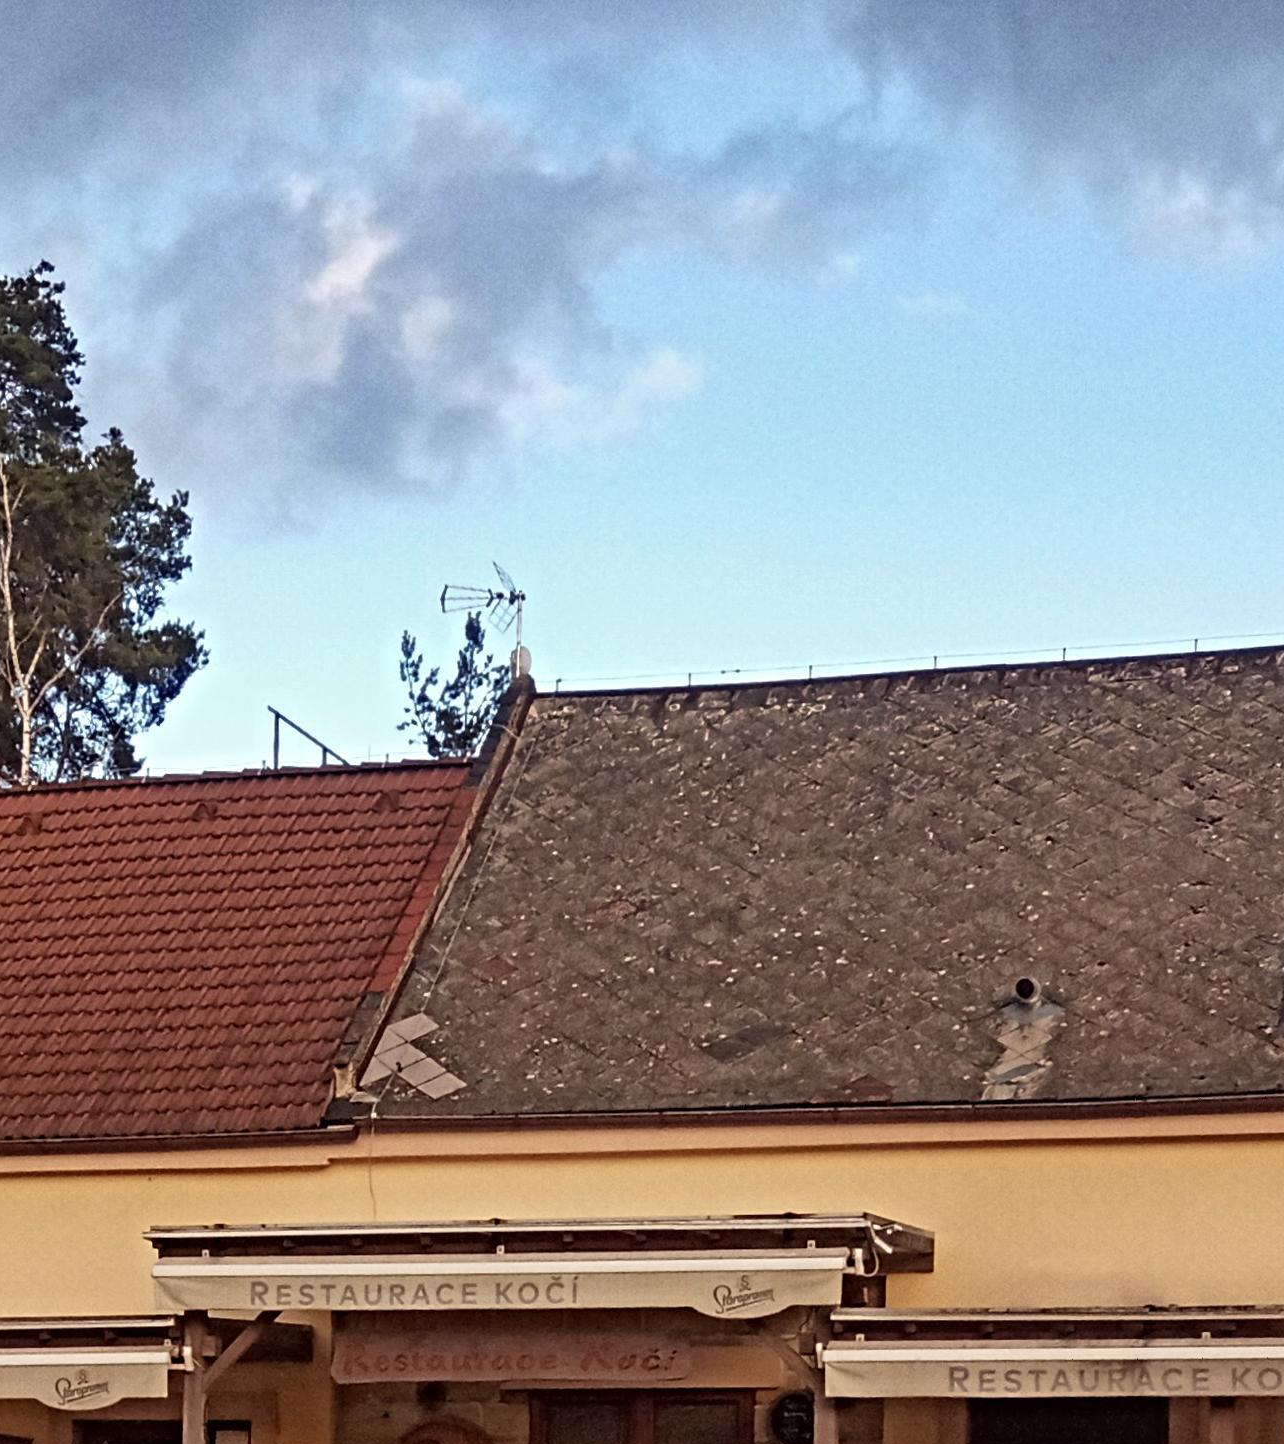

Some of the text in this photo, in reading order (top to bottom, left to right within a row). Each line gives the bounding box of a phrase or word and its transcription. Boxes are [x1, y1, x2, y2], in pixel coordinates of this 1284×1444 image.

[249, 1275, 579, 1306] RESTAURACE KOČÍ
[947, 1365, 1211, 1393] RESTAURACE
